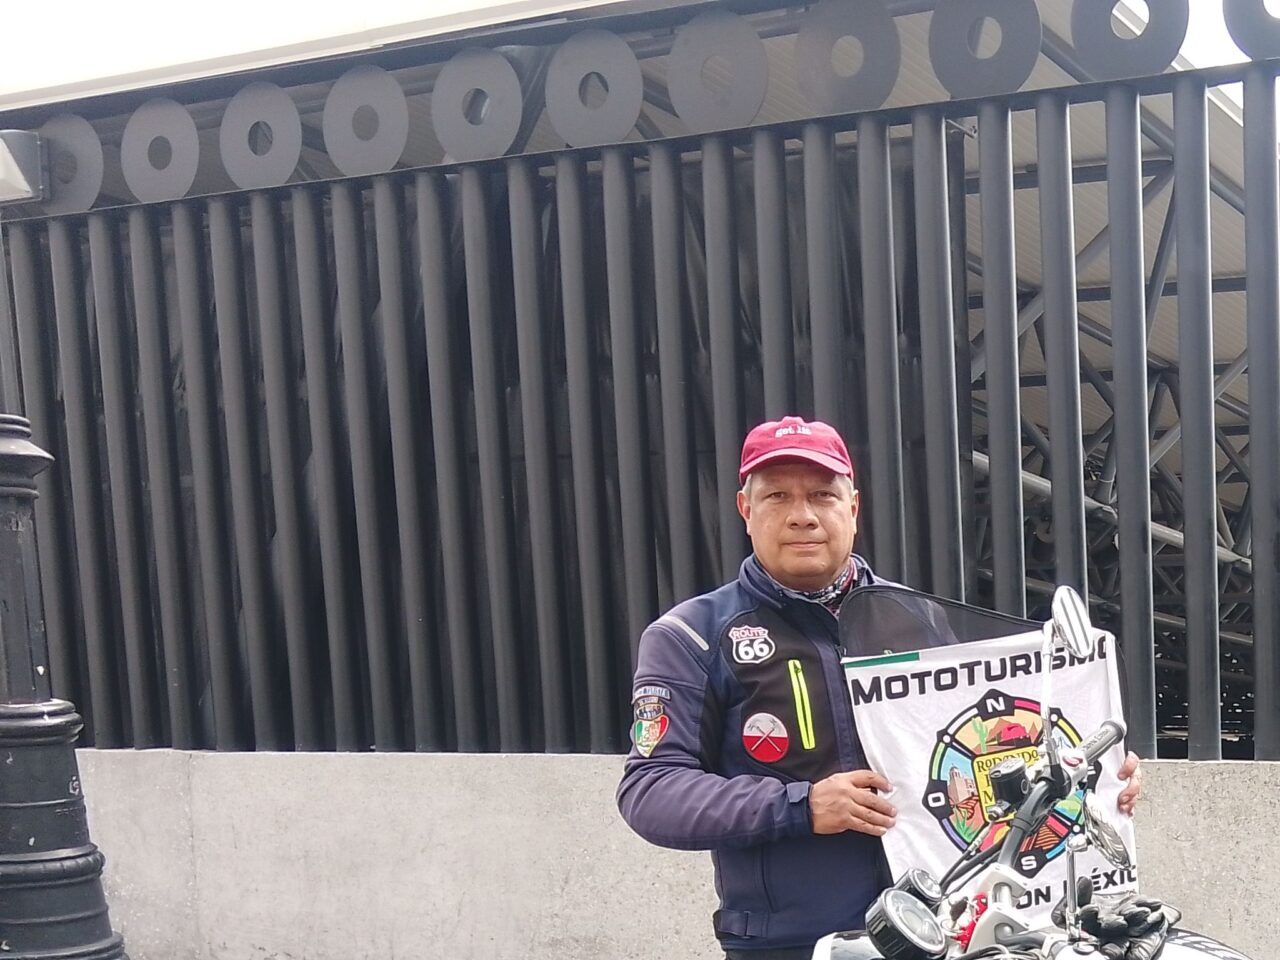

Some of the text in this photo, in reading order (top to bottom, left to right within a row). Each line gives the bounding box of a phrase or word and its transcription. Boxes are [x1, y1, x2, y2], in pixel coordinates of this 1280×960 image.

[732, 629, 766, 639] ROUTE
[738, 638, 769, 660] 66
[985, 696, 1005, 713] N
[927, 792, 945, 807] O
[1021, 856, 1037, 870] S
